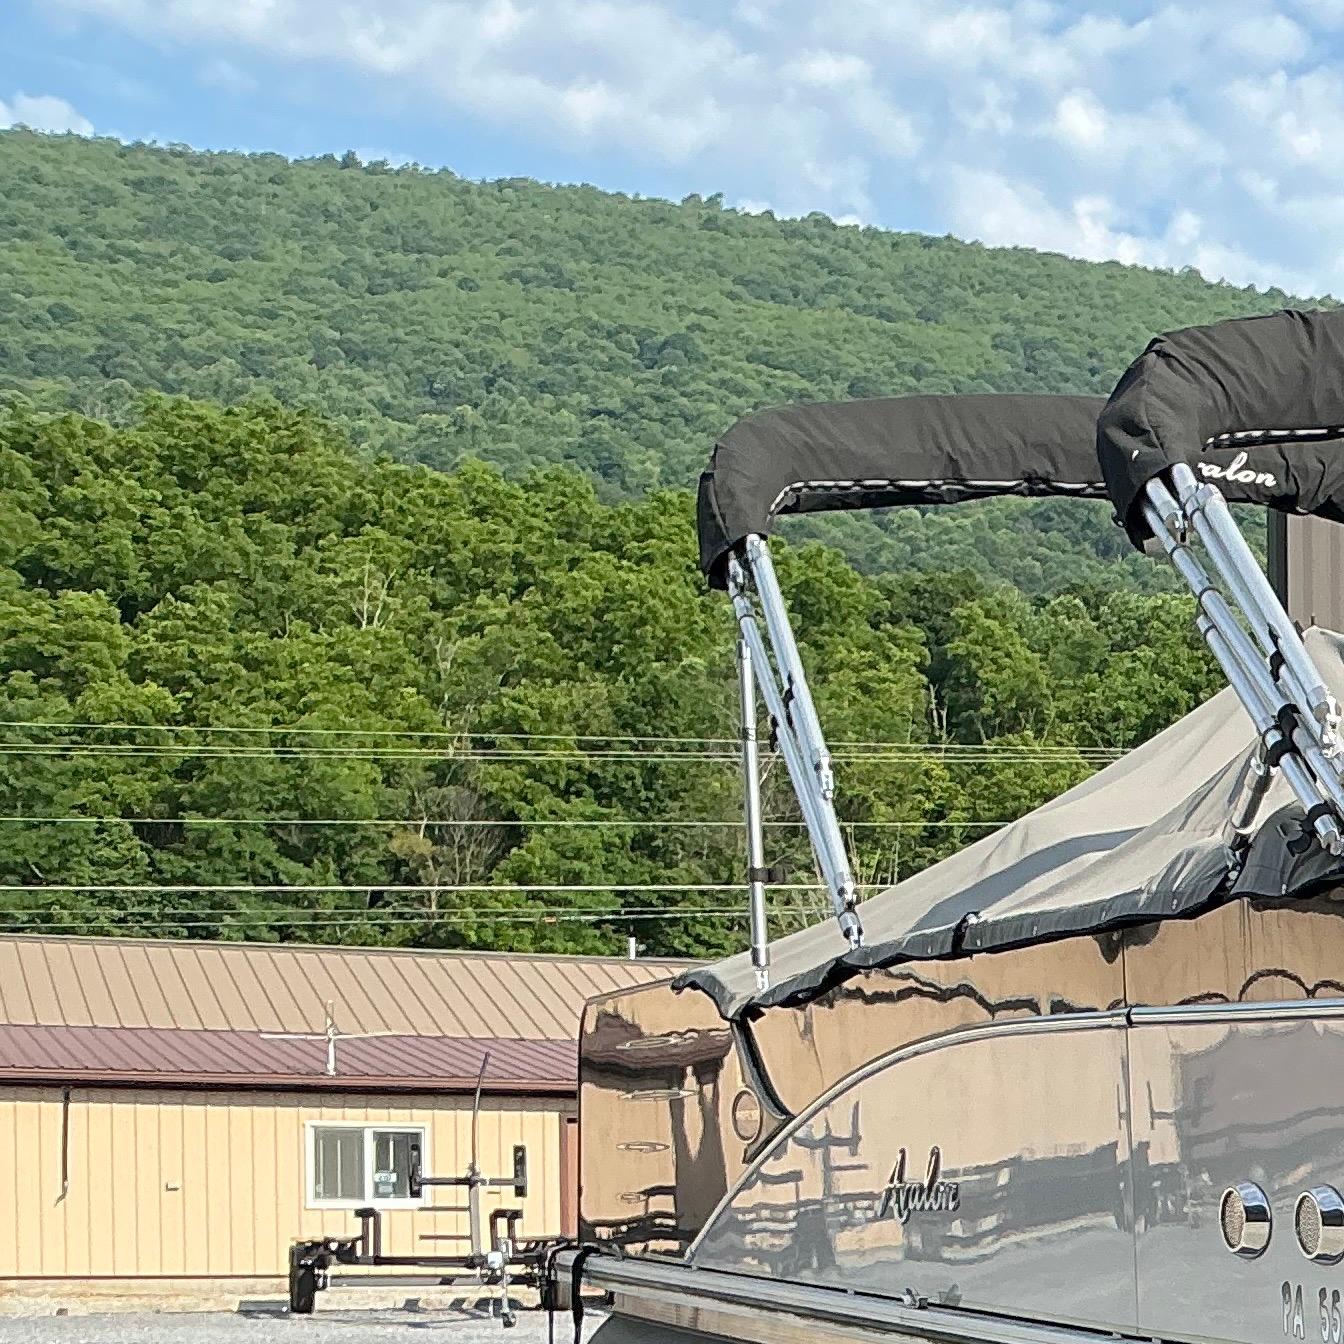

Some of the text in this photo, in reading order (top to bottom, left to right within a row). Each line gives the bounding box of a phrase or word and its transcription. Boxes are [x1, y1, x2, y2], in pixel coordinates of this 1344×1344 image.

[1197, 451, 1277, 487] alon
[876, 1146, 961, 1225] Avalon
[1281, 1280, 1305, 1340] PA
